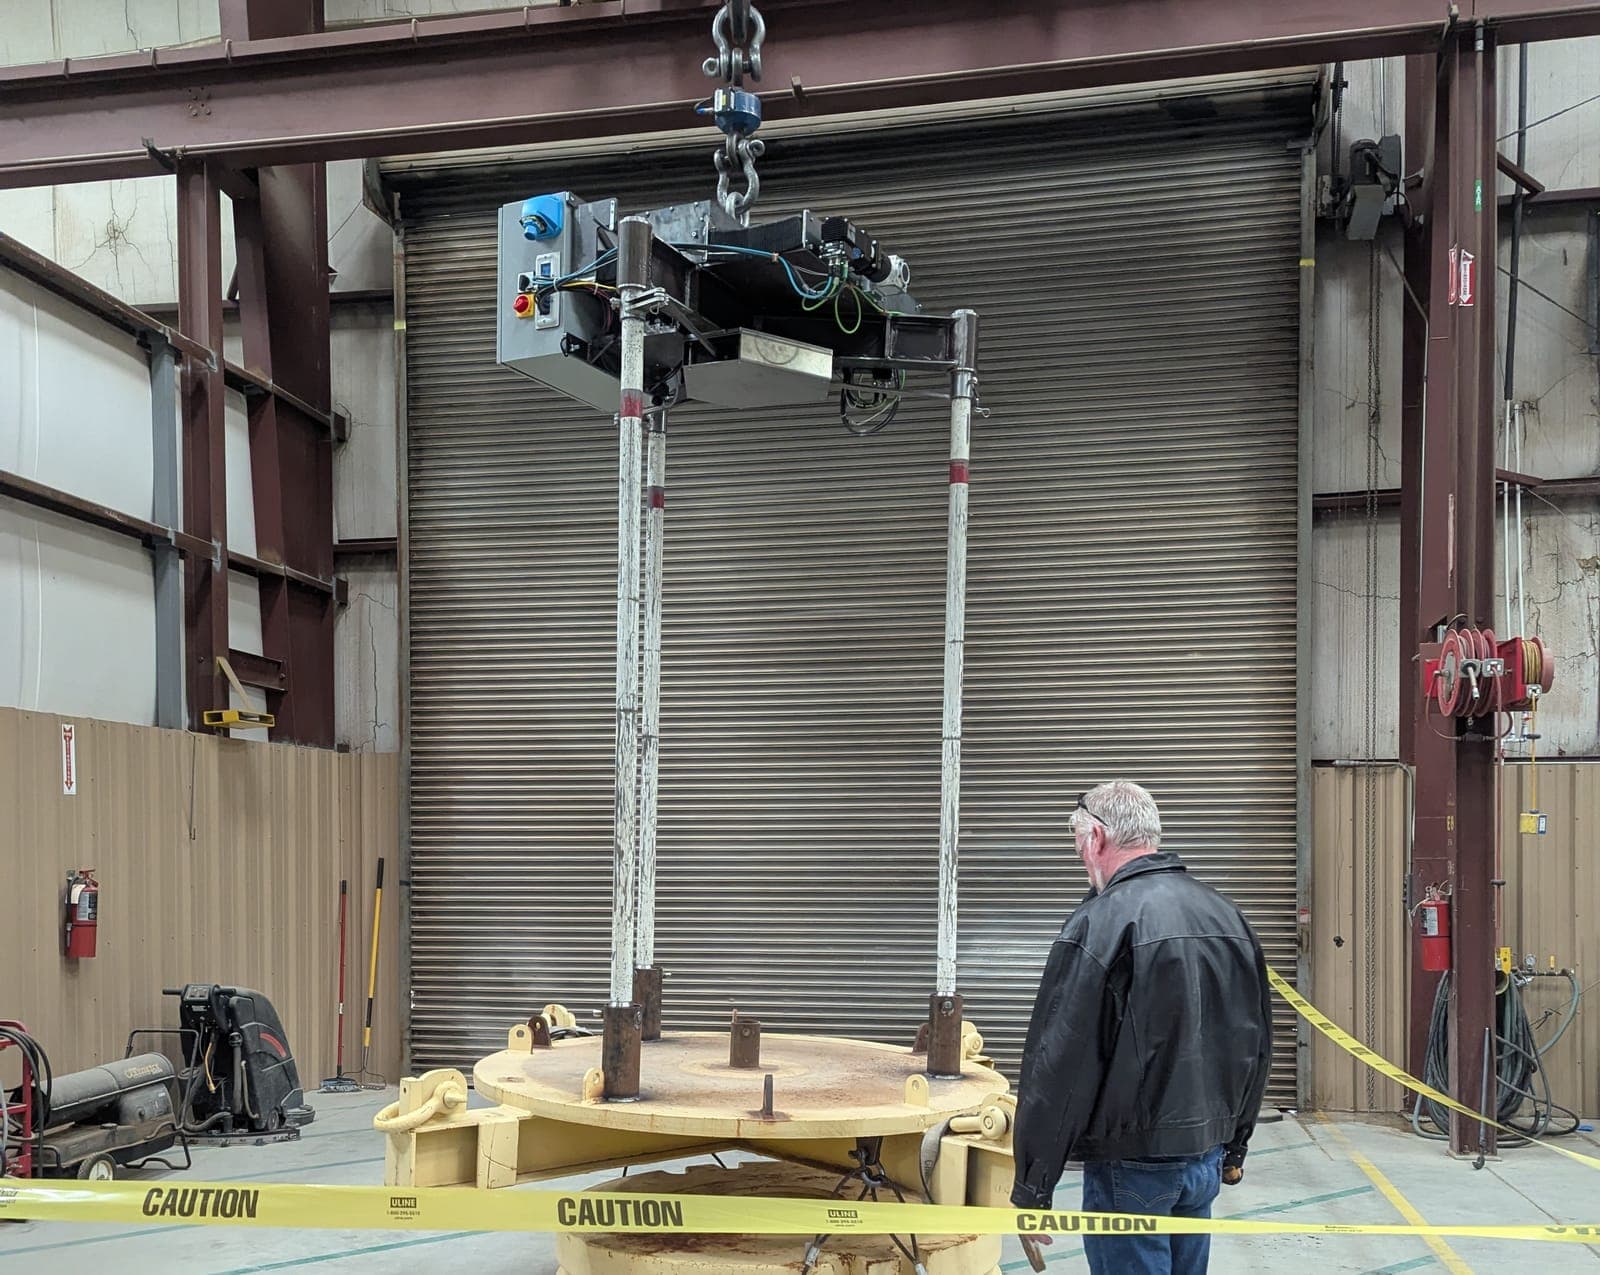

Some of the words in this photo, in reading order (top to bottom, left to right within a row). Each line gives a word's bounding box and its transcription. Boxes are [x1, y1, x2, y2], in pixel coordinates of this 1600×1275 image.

[142, 1188, 259, 1218] CAUTION
[390, 1197, 416, 1208] ULINE
[557, 1197, 683, 1227] CAUTION
[828, 1209, 858, 1218] ULINE
[1016, 1213, 1157, 1232] CAUTION
